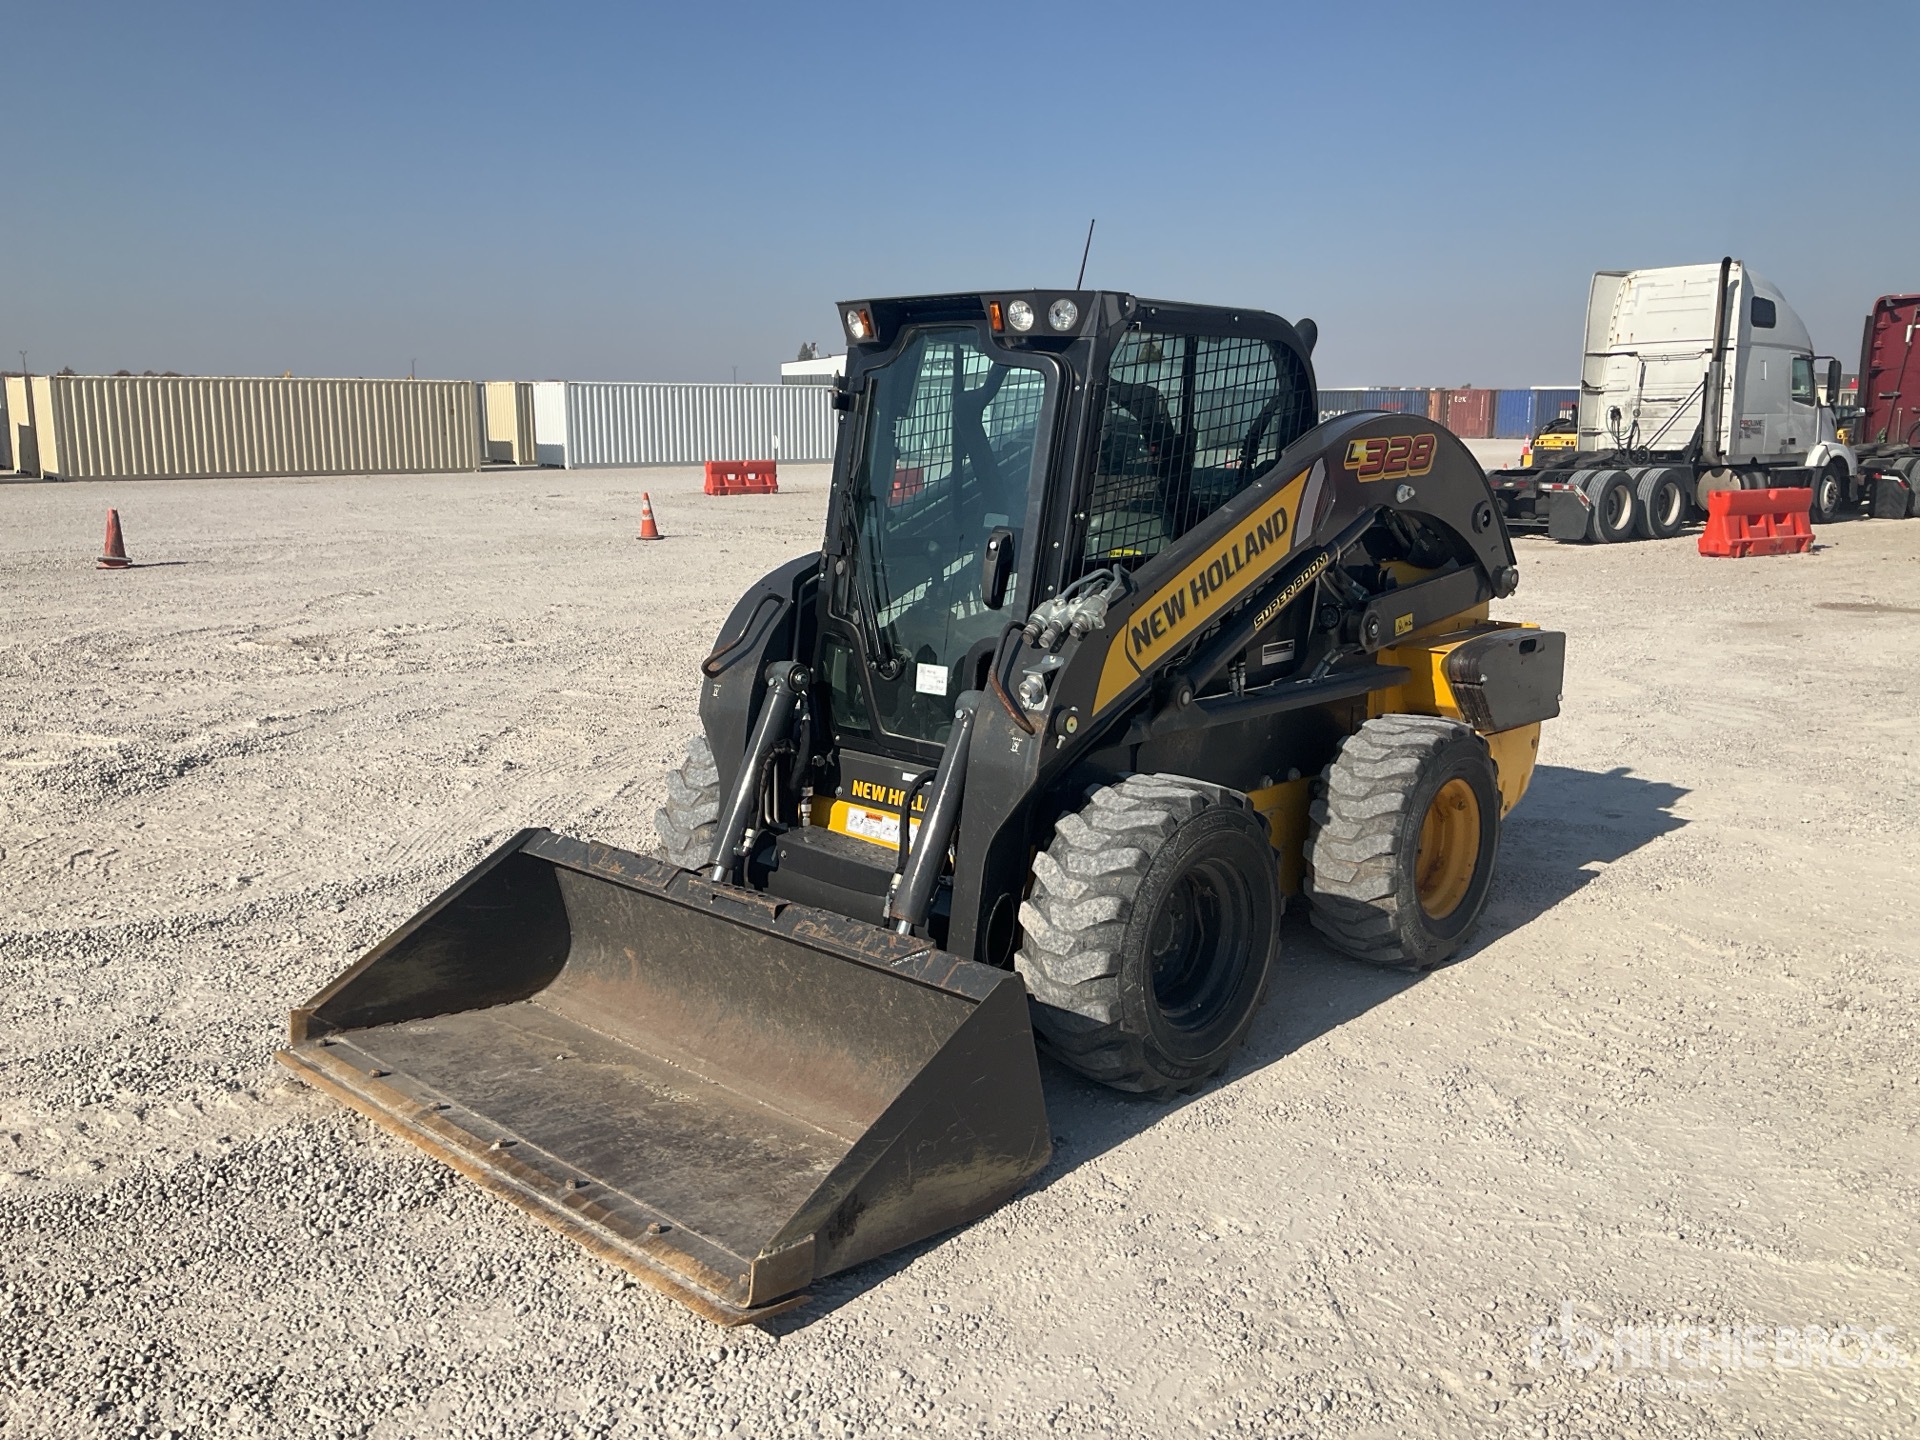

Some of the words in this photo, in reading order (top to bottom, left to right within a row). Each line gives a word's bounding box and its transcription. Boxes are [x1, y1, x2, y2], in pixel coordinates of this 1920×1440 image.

[1344, 433, 1438, 481] L328
[1130, 587, 1187, 656] NEW
[1189, 506, 1289, 608] HOLLAND
[1254, 584, 1295, 631] SUPER
[1294, 552, 1329, 593] BOOM
[851, 779, 886, 802] NEW
